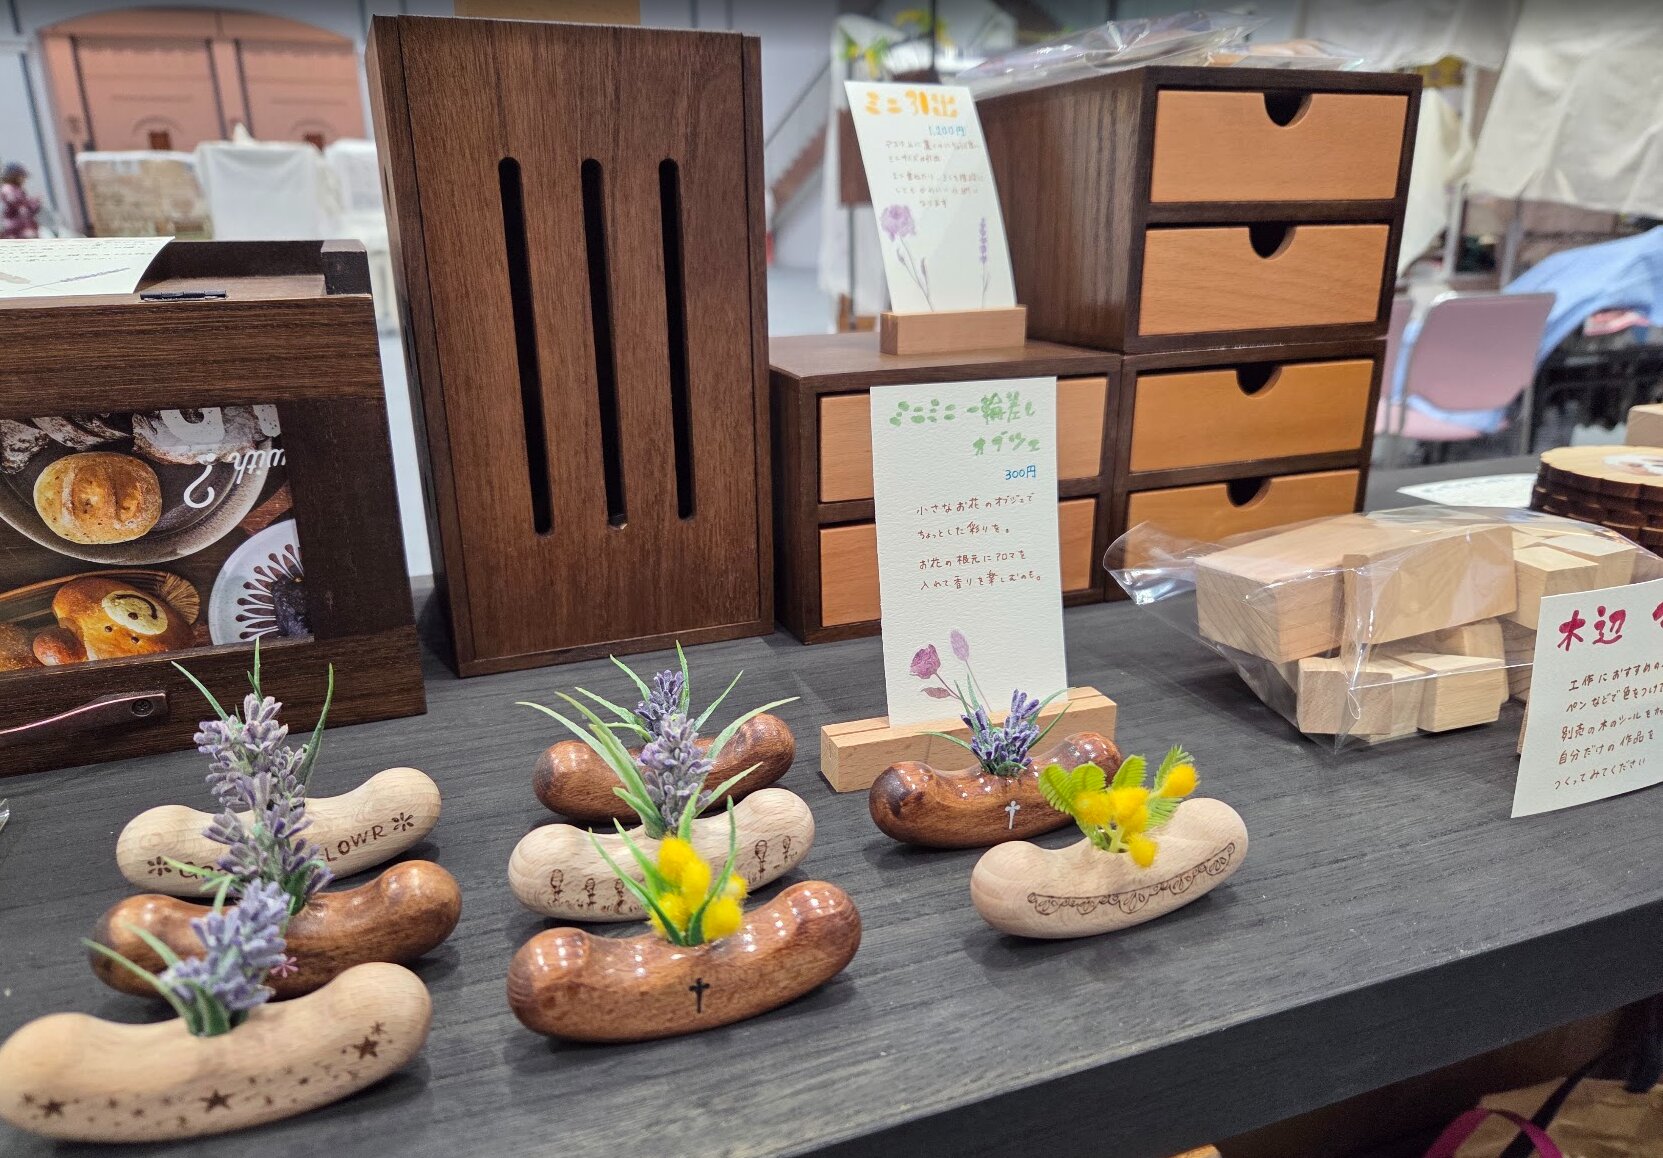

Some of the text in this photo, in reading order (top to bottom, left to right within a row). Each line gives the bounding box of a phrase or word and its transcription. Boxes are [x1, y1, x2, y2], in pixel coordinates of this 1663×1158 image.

[1005, 465, 1036, 480] 300円
[1568, 662, 1663, 692] 工作におすすめの
